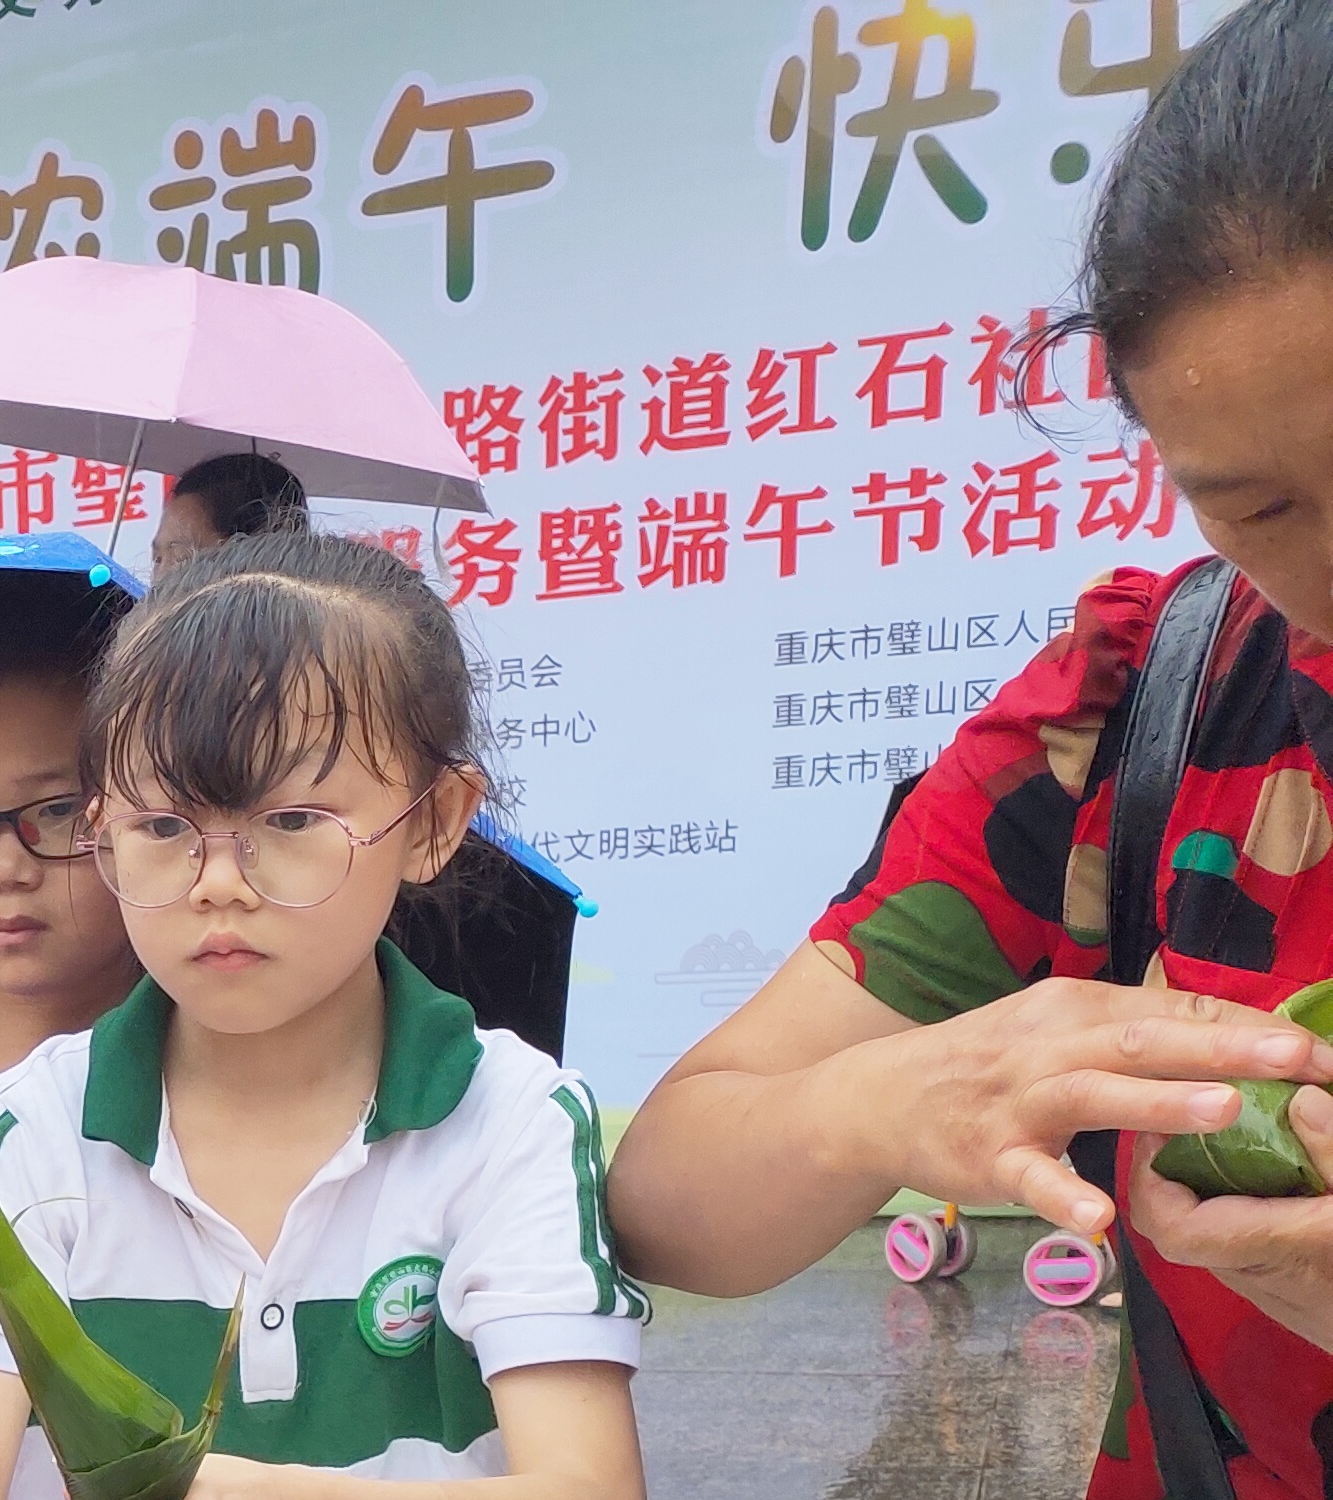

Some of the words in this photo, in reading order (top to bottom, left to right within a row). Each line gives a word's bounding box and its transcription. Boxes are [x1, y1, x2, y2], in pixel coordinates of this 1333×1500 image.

[443, 305, 1107, 475] 路街道红石社
[347, 437, 1177, 609] 务暨端午节活动
[772, 678, 998, 729] 重庆市璧山区
